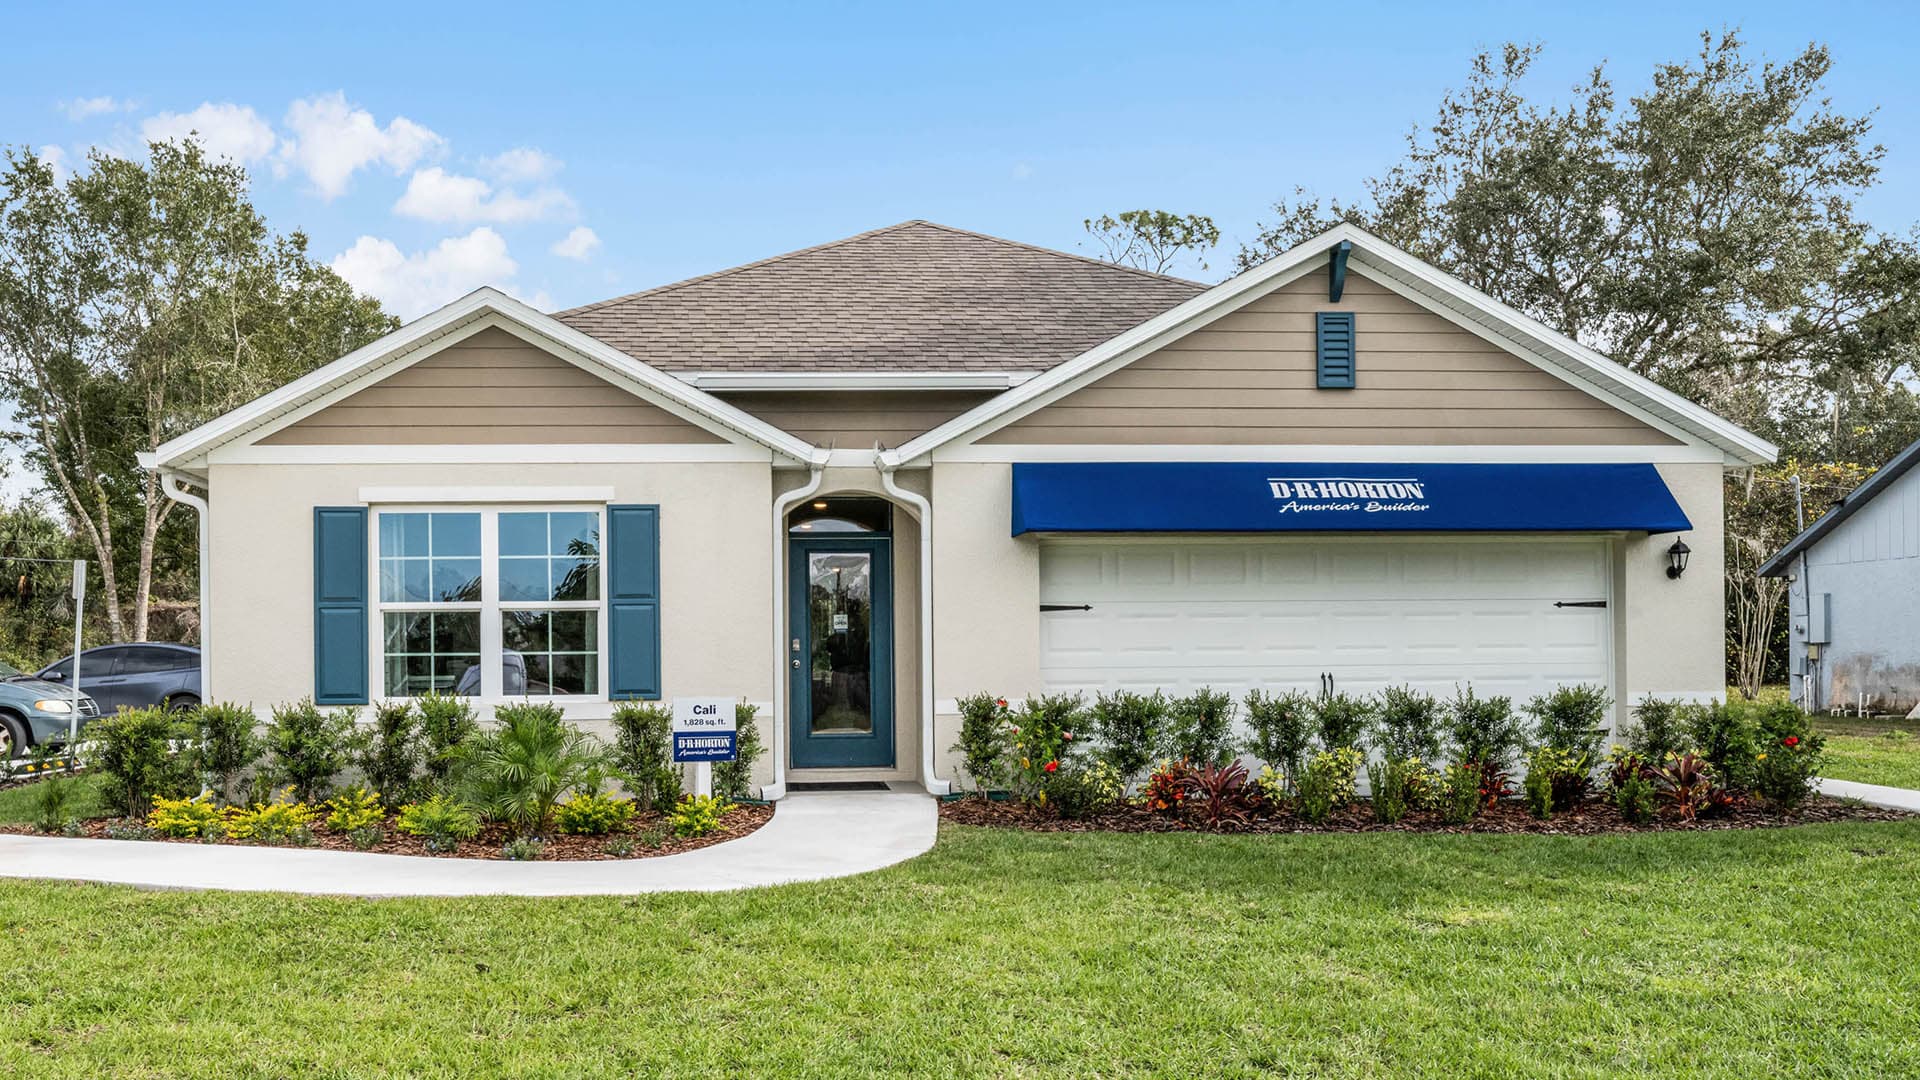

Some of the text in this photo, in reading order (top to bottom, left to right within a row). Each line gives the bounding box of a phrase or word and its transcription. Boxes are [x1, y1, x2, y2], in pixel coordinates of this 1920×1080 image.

[1279, 501, 1430, 513] America's Builder
[693, 705, 716, 715] Cali
[683, 719, 704, 727] 1,828
[705, 719, 716, 727] sq.
